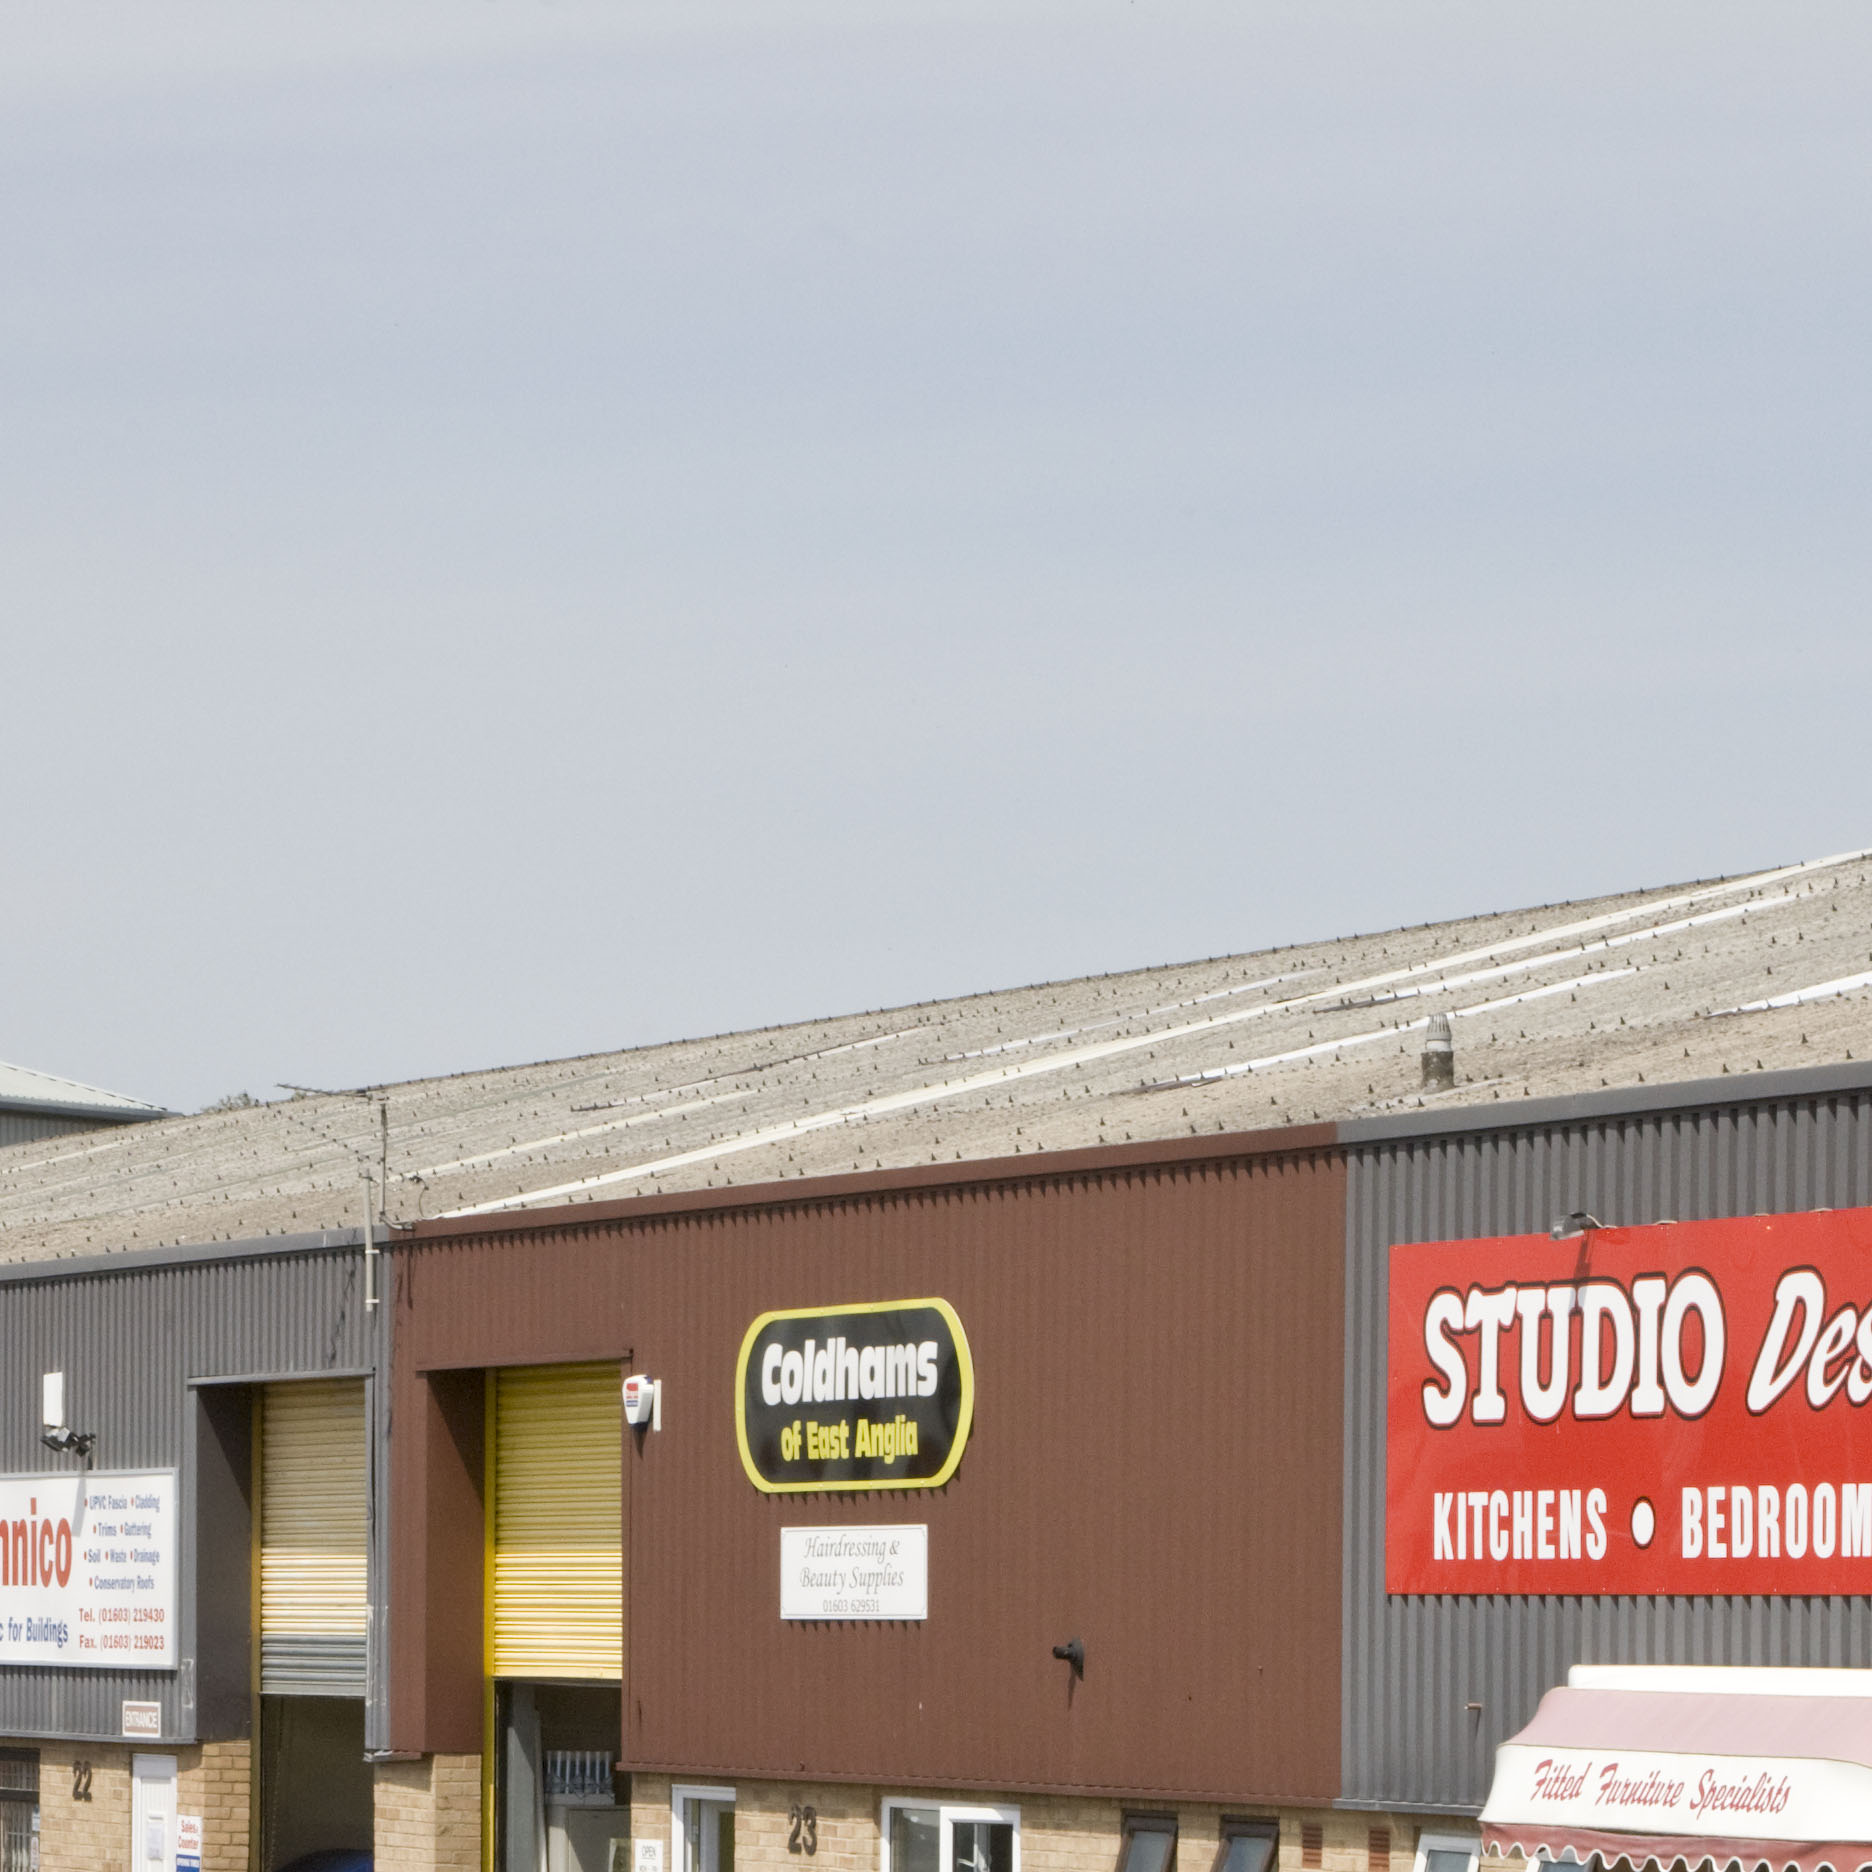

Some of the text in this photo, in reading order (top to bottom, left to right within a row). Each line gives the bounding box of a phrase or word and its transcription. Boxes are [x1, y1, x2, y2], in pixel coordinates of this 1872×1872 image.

[762, 1336, 938, 1406] Coldhams
[1424, 1272, 1725, 1426] STUDIO
[781, 1414, 918, 1464] of East Anglia
[804, 1534, 900, 1564] Hairdressing &
[1433, 1487, 1607, 1561] KITCHENS
[800, 1563, 904, 1595] Beauty Supplies
[8, 1616, 22, 1641] for
[26, 1616, 68, 1648] Buildings
[73, 1760, 93, 1802] 22
[1531, 1758, 1791, 1821] Fitted Furniture Specialists
[788, 1805, 818, 1857] 23
